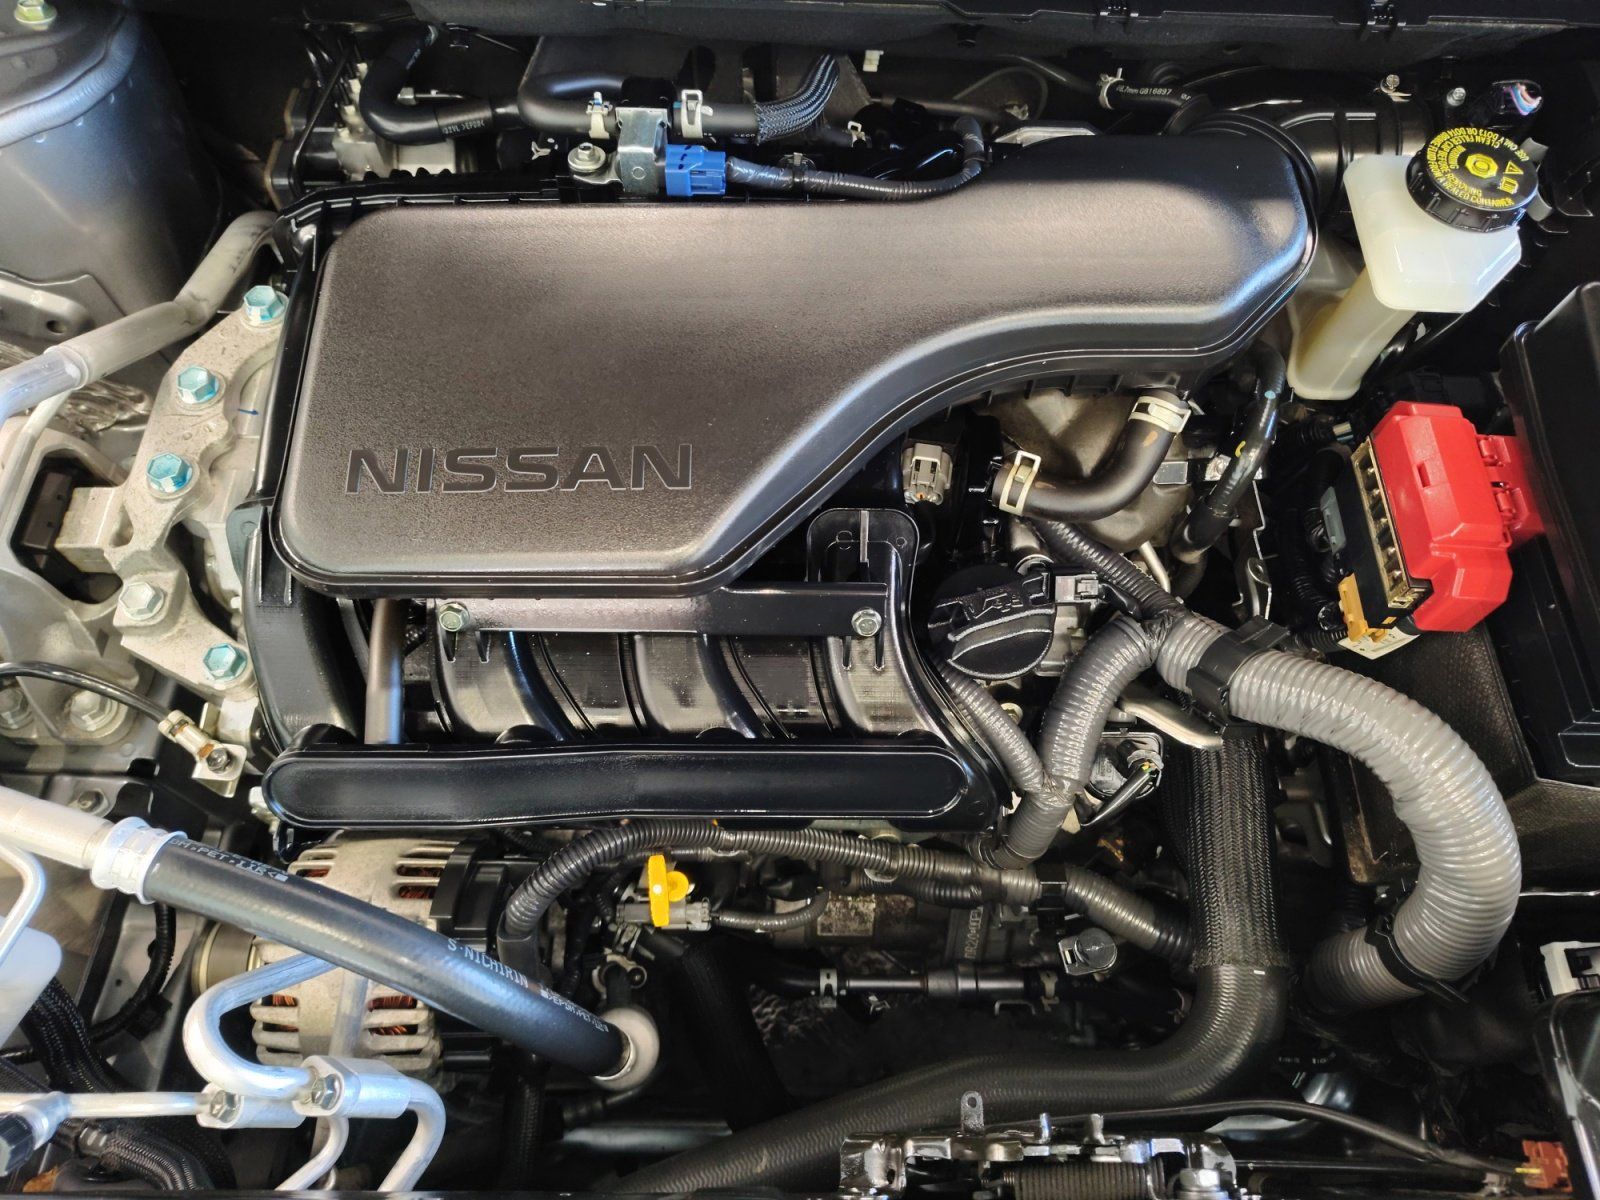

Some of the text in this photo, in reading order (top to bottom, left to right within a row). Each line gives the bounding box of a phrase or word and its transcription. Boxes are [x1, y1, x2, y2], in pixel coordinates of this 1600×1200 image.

[1466, 127, 1478, 136] OR
[1440, 140, 1454, 151] CAP
[1449, 134, 1475, 146] FILLER
[1475, 135, 1500, 149] CLEAN
[1448, 145, 1466, 169] WARNING
[345, 444, 692, 493] NISSAN
